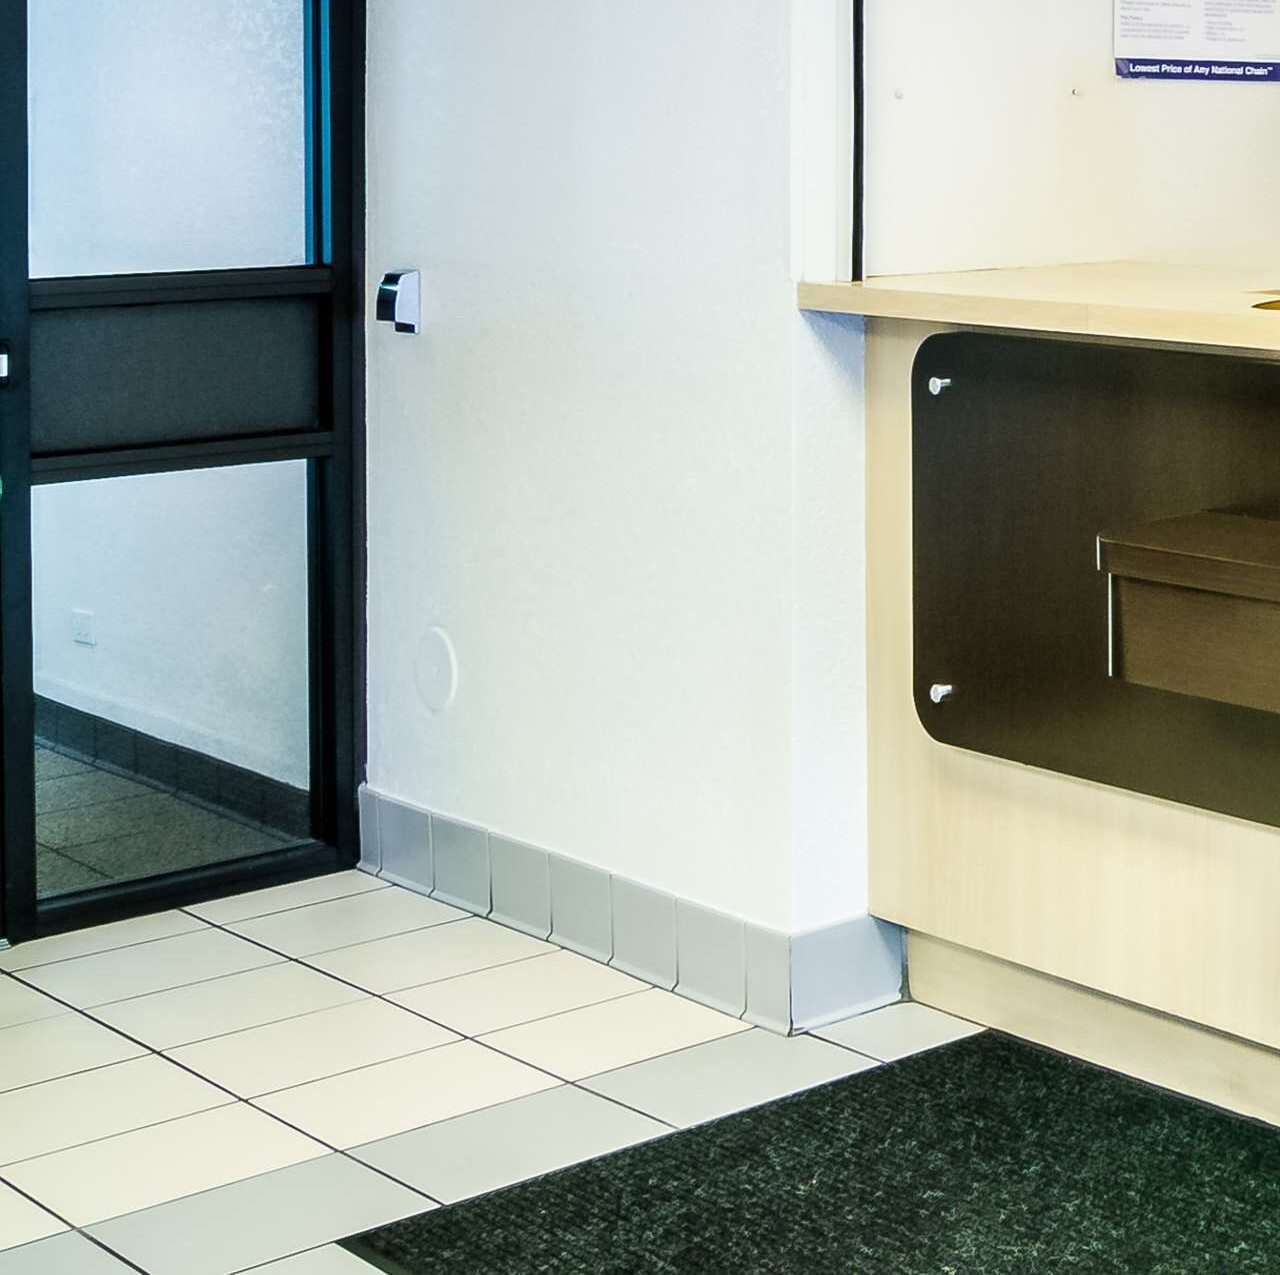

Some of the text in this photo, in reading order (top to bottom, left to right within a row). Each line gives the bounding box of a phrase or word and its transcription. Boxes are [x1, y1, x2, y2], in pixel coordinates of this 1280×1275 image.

[1129, 63, 1160, 73] Lowest
[1161, 64, 1182, 74] Price
[1183, 65, 1192, 74] of
[1193, 66, 1209, 77] Any
[1210, 66, 1243, 76] National
